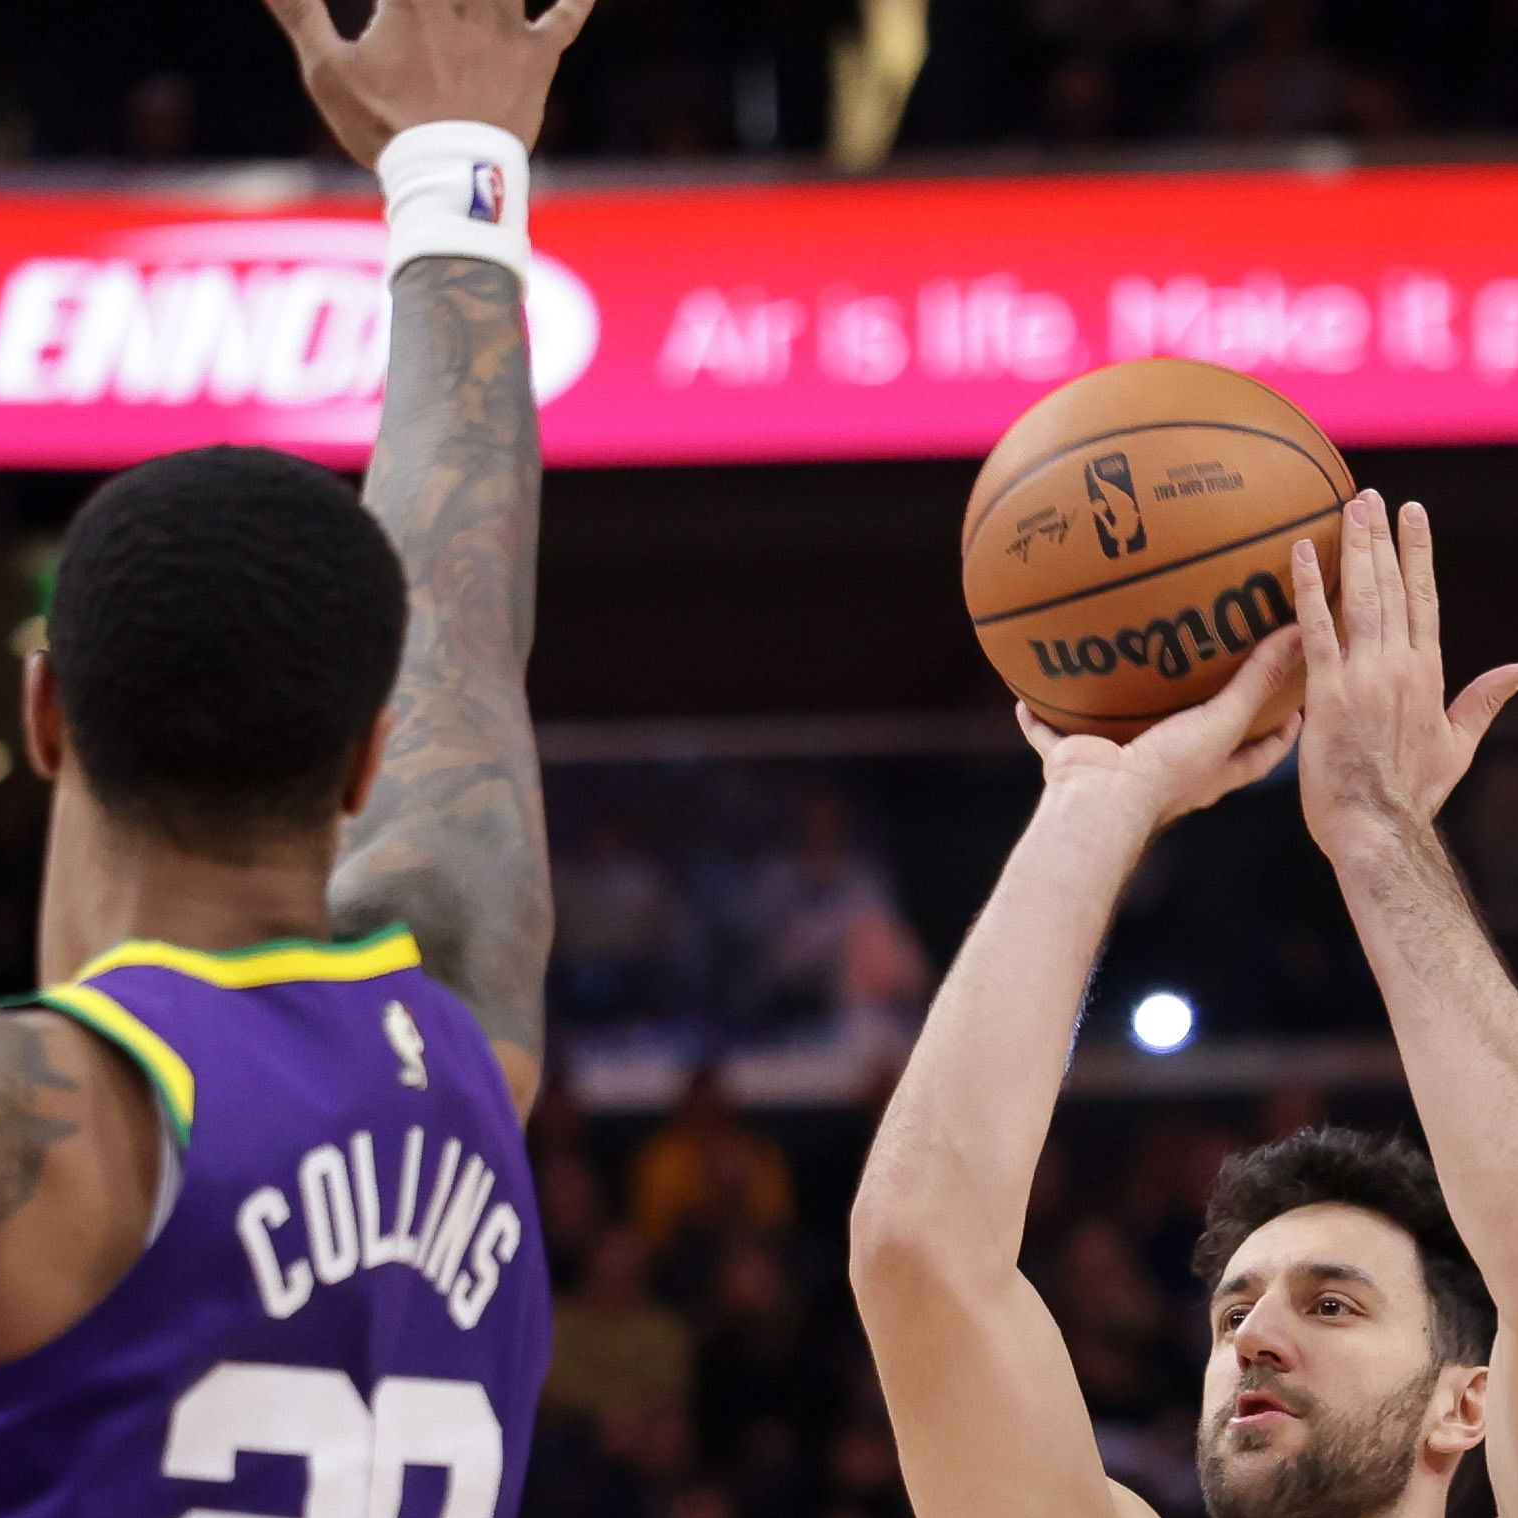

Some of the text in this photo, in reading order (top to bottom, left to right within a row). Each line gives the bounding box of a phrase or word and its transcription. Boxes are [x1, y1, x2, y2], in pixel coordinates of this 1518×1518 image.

[656, 285, 806, 390] Air
[815, 281, 911, 386] is
[1107, 267, 1373, 374] Make
[1378, 265, 1461, 372] it
[1028, 572, 1297, 679] Wilson
[236, 1125, 522, 1331] COLLINS
